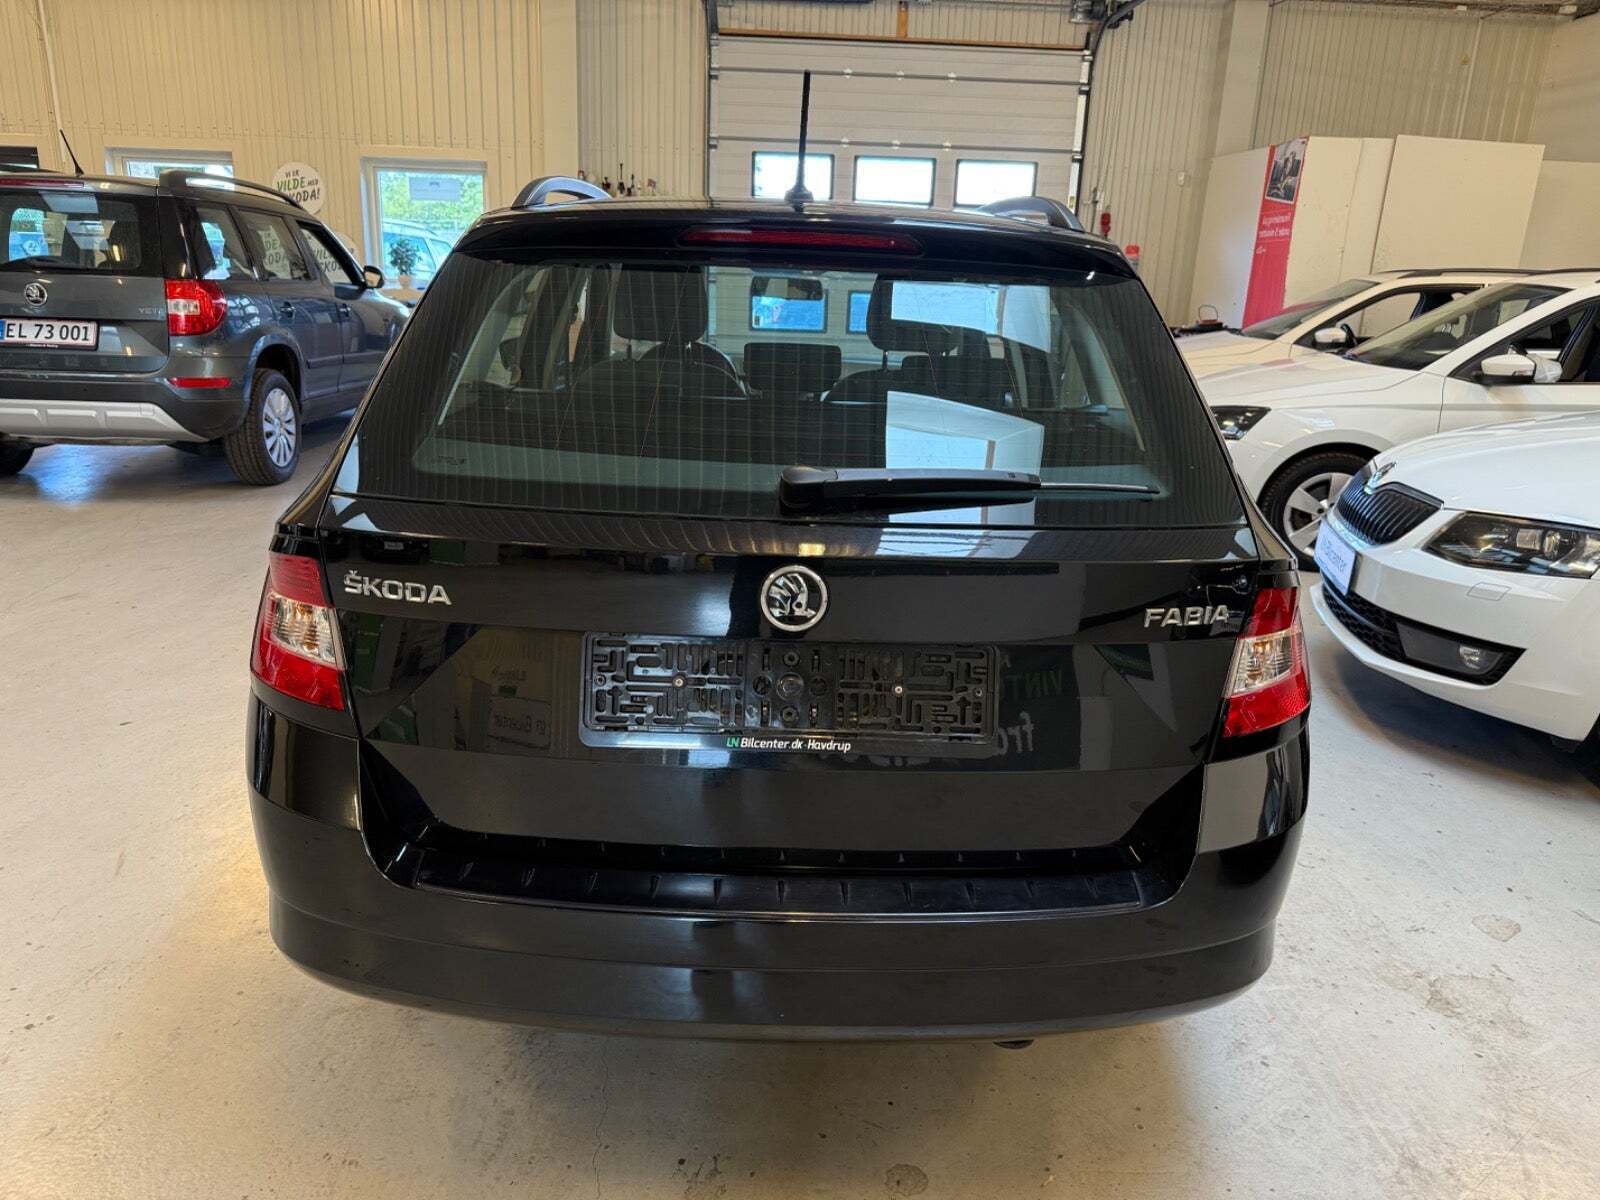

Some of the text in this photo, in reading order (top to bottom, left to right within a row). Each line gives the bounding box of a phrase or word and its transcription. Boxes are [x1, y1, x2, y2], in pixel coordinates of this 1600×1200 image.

[277, 176, 305, 191] VILDE
[6, 322, 90, 342] EL 73 001
[343, 569, 452, 606] ŠKODA
[1143, 604, 1230, 628] FABIA
[726, 736, 741, 748] LN
